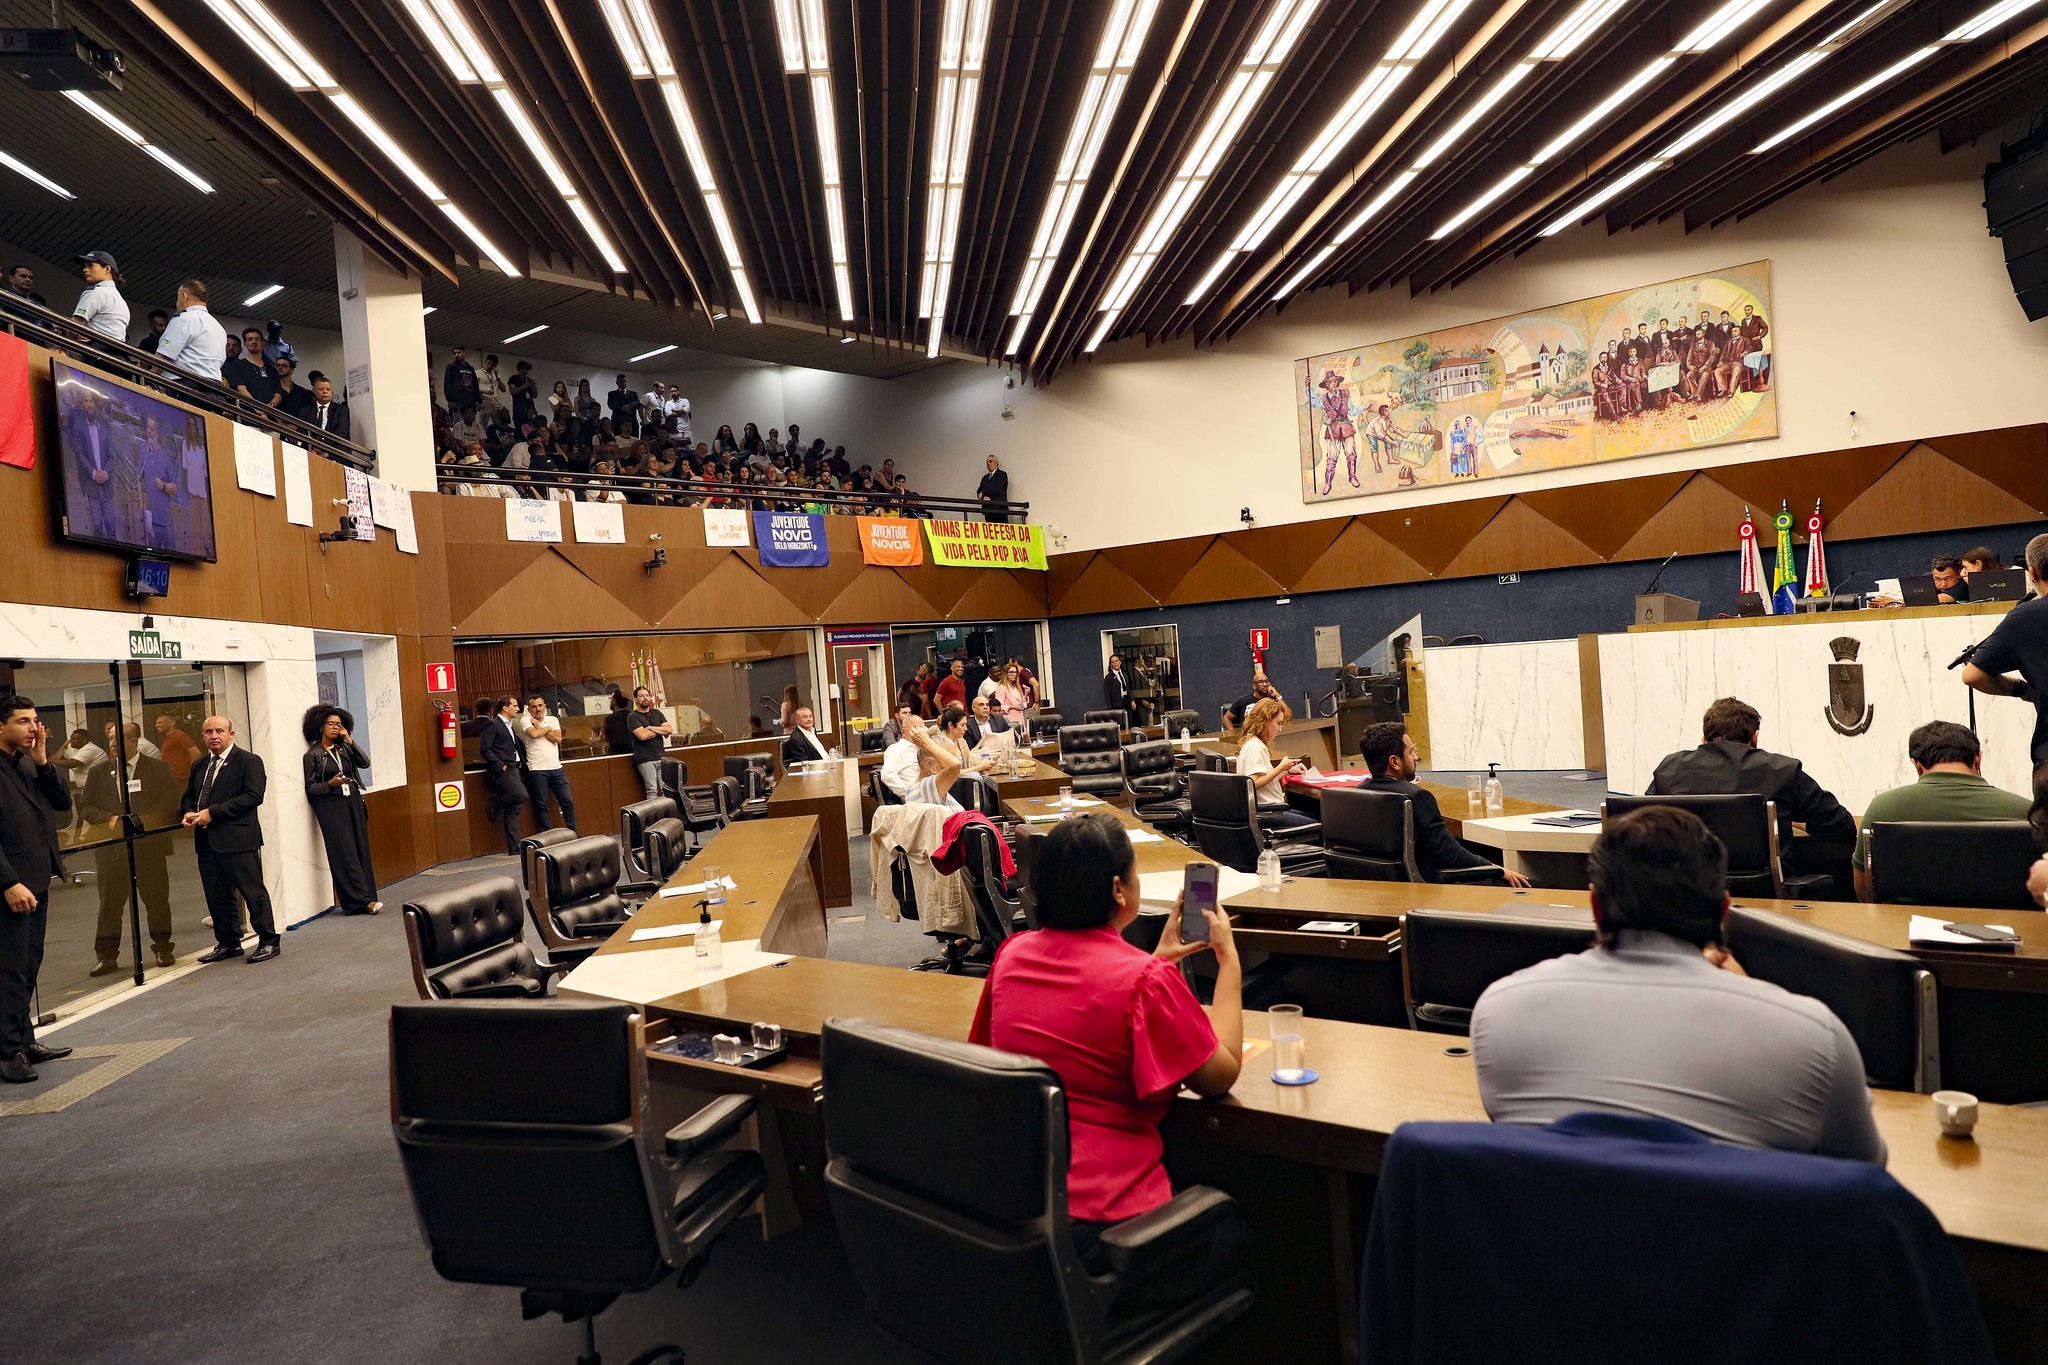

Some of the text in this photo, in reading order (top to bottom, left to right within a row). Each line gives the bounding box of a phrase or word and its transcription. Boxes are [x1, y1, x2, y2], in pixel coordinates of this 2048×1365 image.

[771, 515, 811, 529] JUVENTUDE
[771, 529, 813, 541] NOVO
[870, 523, 909, 540] JUVENTUDE
[930, 519, 1031, 543] MINAS EM DEFESA DA
[774, 541, 788, 550] BELO
[872, 538, 902, 550] NOVO
[941, 542, 1030, 563] VIDA PELA POP RUA
[140, 568, 168, 587] 16:10
[130, 631, 161, 655] SAÍDA
